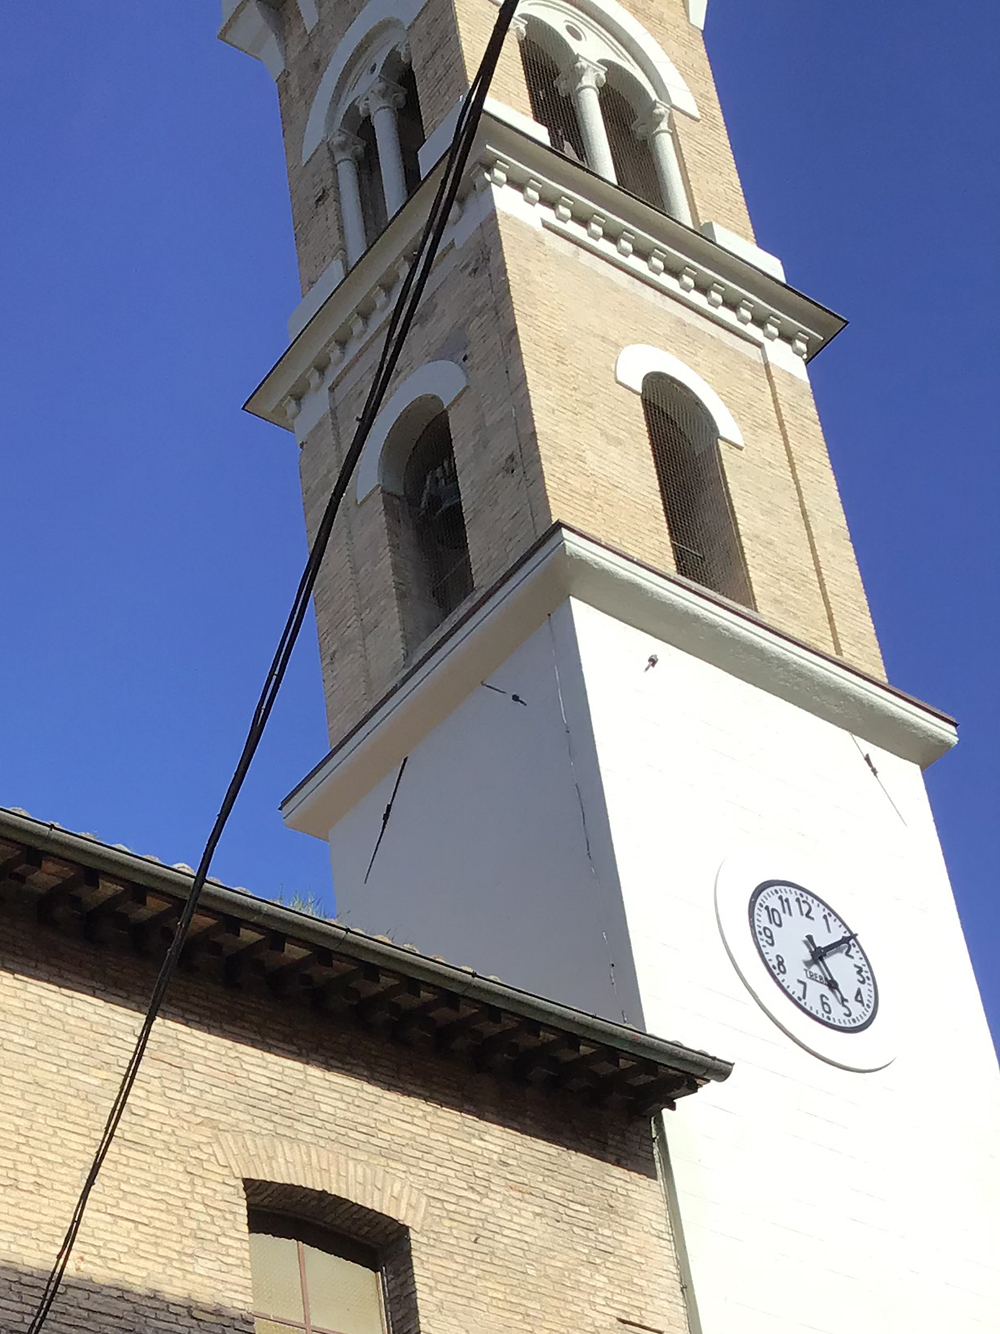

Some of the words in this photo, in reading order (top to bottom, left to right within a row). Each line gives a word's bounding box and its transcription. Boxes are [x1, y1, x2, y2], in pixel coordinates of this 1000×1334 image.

[764, 905, 783, 928] 10
[778, 895, 793, 917] 11
[795, 897, 815, 921] 12
[822, 914, 832, 934] 1
[763, 926, 775, 947] 9
[775, 954, 787, 975] 8
[853, 964, 866, 985] 3
[797, 978, 808, 1000] 7
[854, 987, 866, 1008] 4
[820, 994, 832, 1015] 6
[841, 998, 853, 1018] 5
